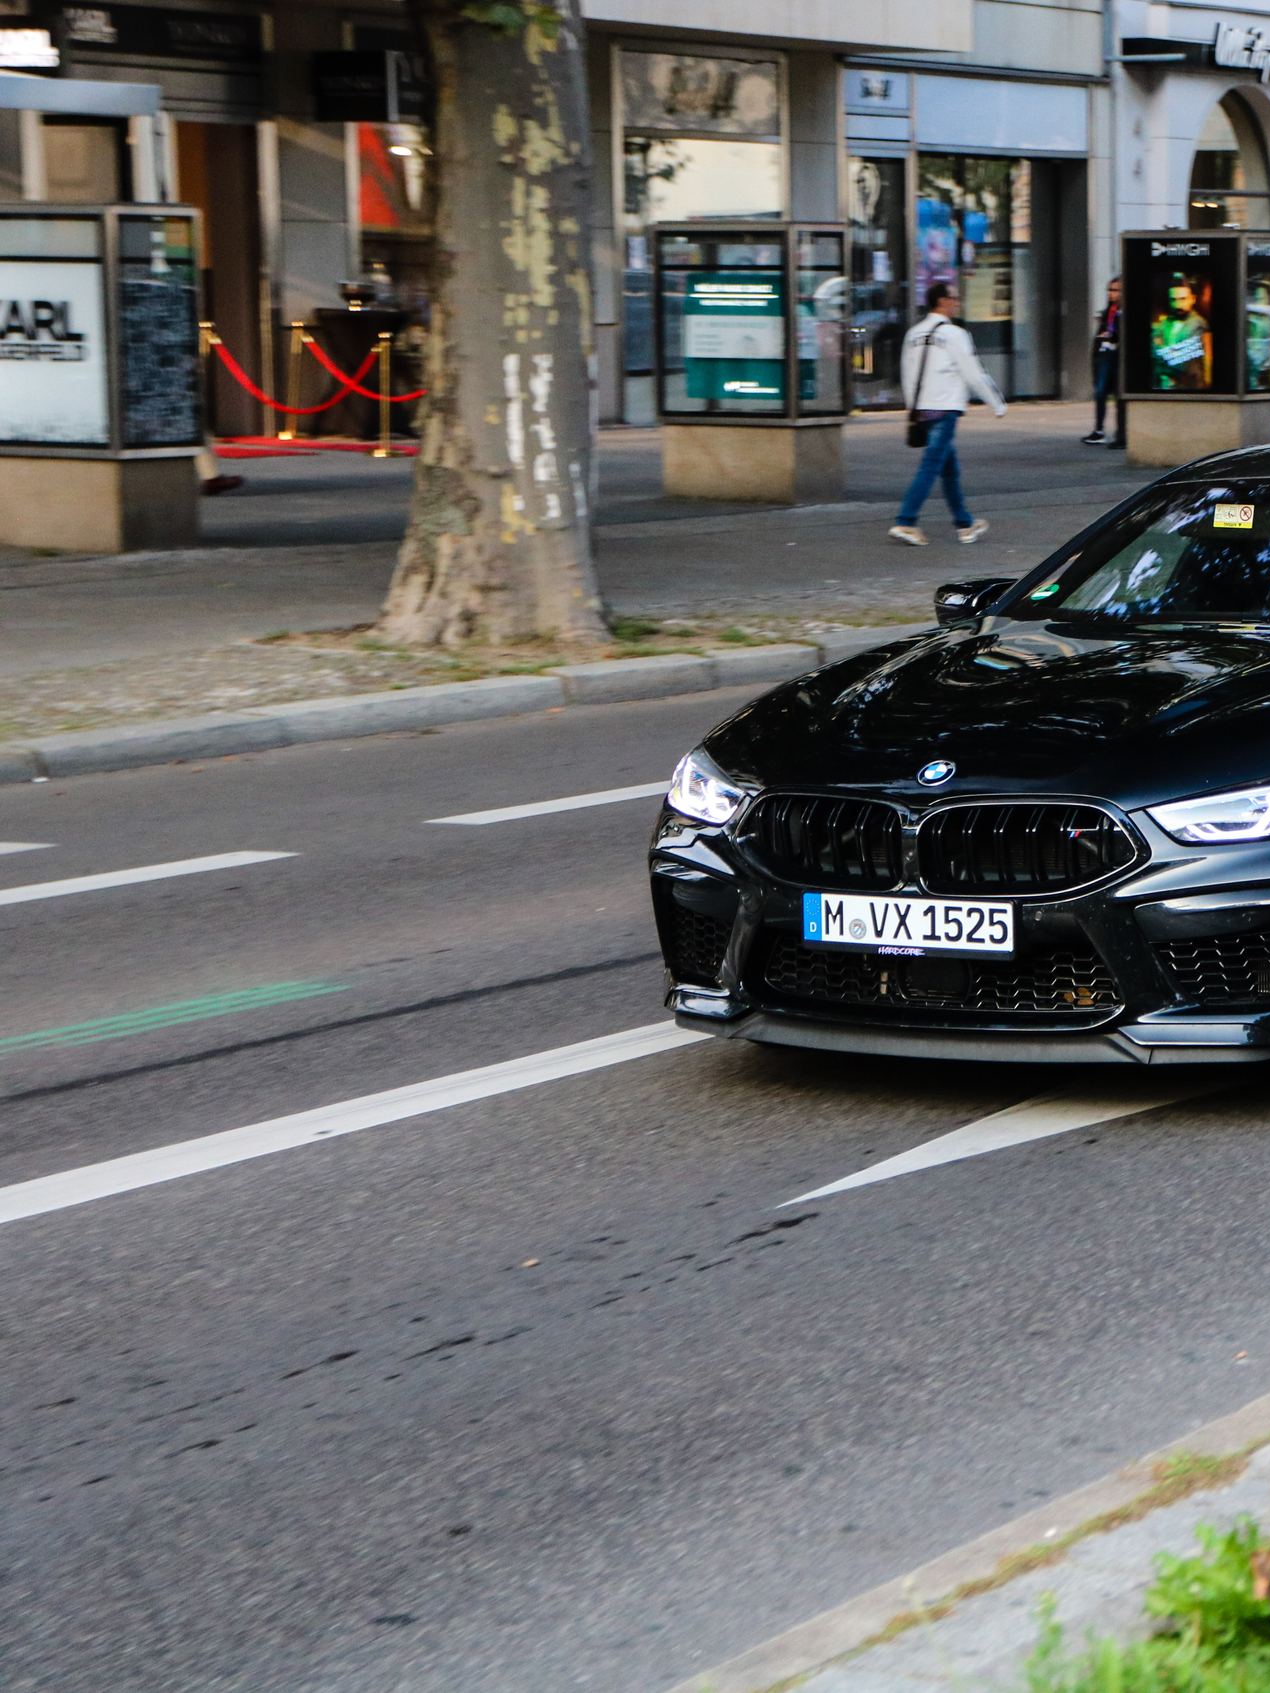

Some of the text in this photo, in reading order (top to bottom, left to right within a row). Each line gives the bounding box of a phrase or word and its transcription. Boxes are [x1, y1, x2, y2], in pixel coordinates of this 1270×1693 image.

[824, 899, 1009, 944] M VX 1525
[809, 922, 818, 932] D
[878, 946, 926, 956] HARDCORE
